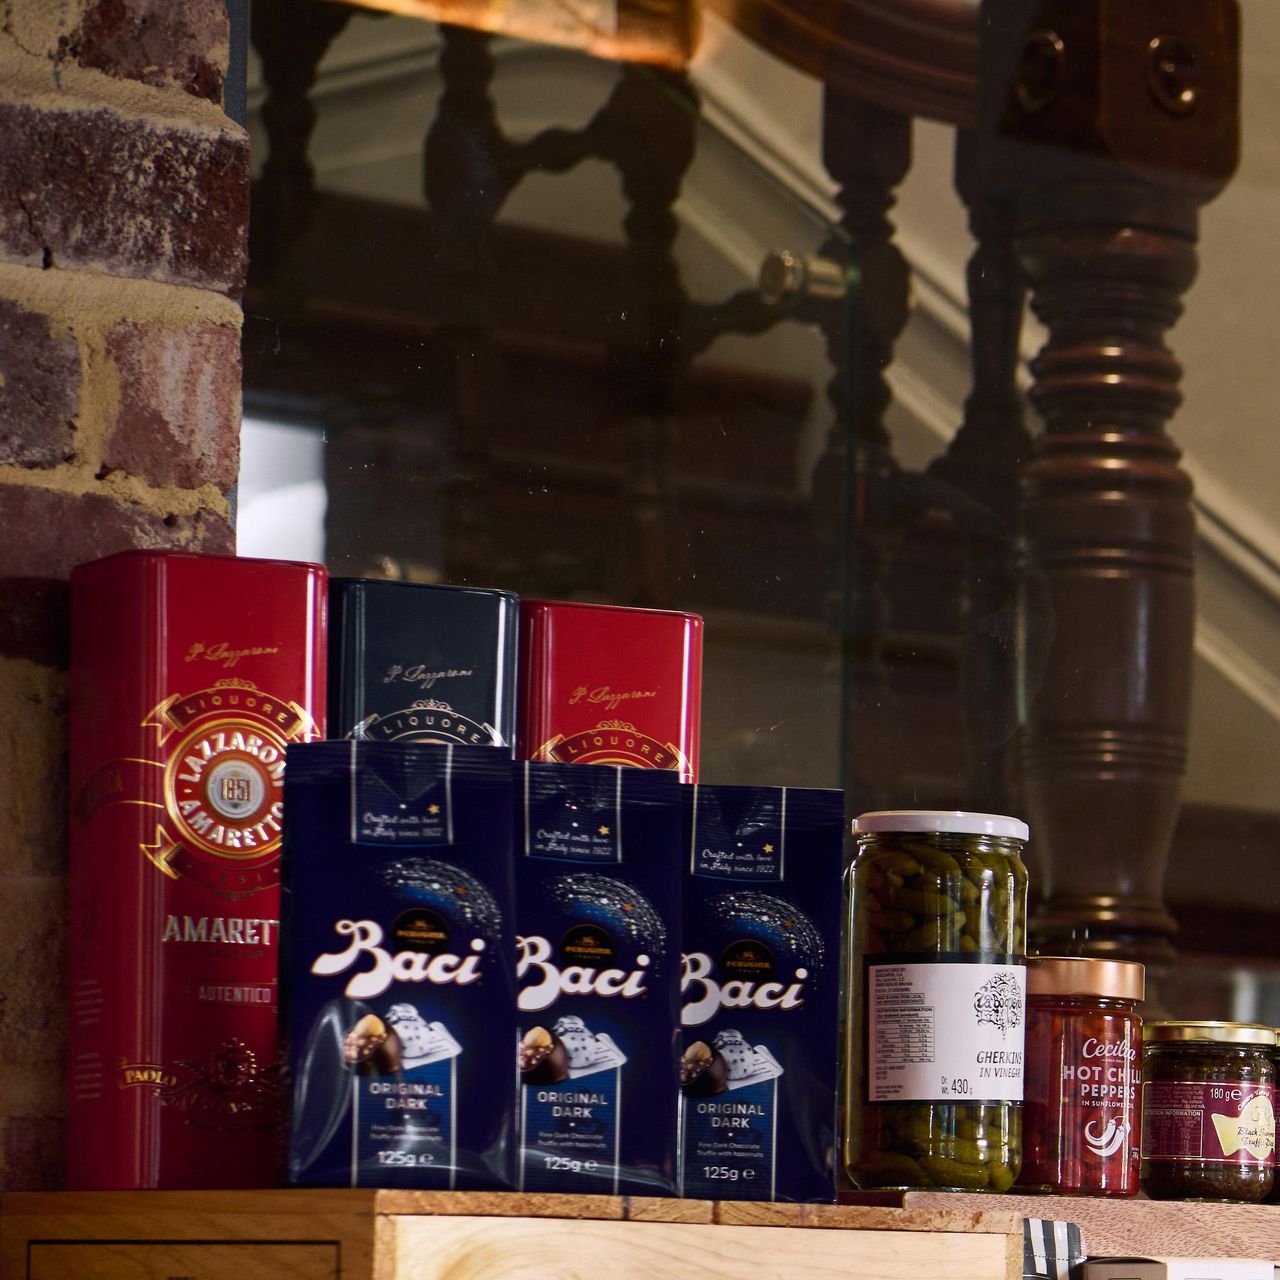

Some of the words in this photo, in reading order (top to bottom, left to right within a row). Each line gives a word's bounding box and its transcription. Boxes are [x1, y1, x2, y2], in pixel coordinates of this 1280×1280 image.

[185, 695, 288, 724] LIQUORE
[383, 715, 481, 743] LIQUORE
[567, 735, 663, 763] LIQUORE
[702, 846, 734, 863] Crafted
[735, 851, 755, 862] with
[733, 864, 755, 874] since
[756, 863, 776, 874] 1922
[311, 919, 486, 1000] Baci
[515, 934, 651, 1013] Baci
[680, 952, 809, 1027] Baci
[976, 1050, 1023, 1065] GHERKINS
[1082, 1037, 1137, 1061] Cecilia
[979, 1067, 990, 1078] IN
[994, 1067, 1021, 1078] VINEGAR
[1062, 1065, 1102, 1081] HOT
[369, 1082, 445, 1097] ORIGINAL
[951, 1078, 969, 1095] 430
[1081, 1083, 1136, 1100] PEPPES
[1210, 1087, 1224, 1100] 180
[385, 1097, 429, 1111] DARK
[536, 1090, 609, 1106] ORIGINAL
[552, 1105, 593, 1119] DARK
[696, 1102, 766, 1116] ORIGINAL
[711, 1116, 751, 1130] DARK
[543, 1156, 582, 1173] 125g
[702, 1165, 740, 1182] 125g
